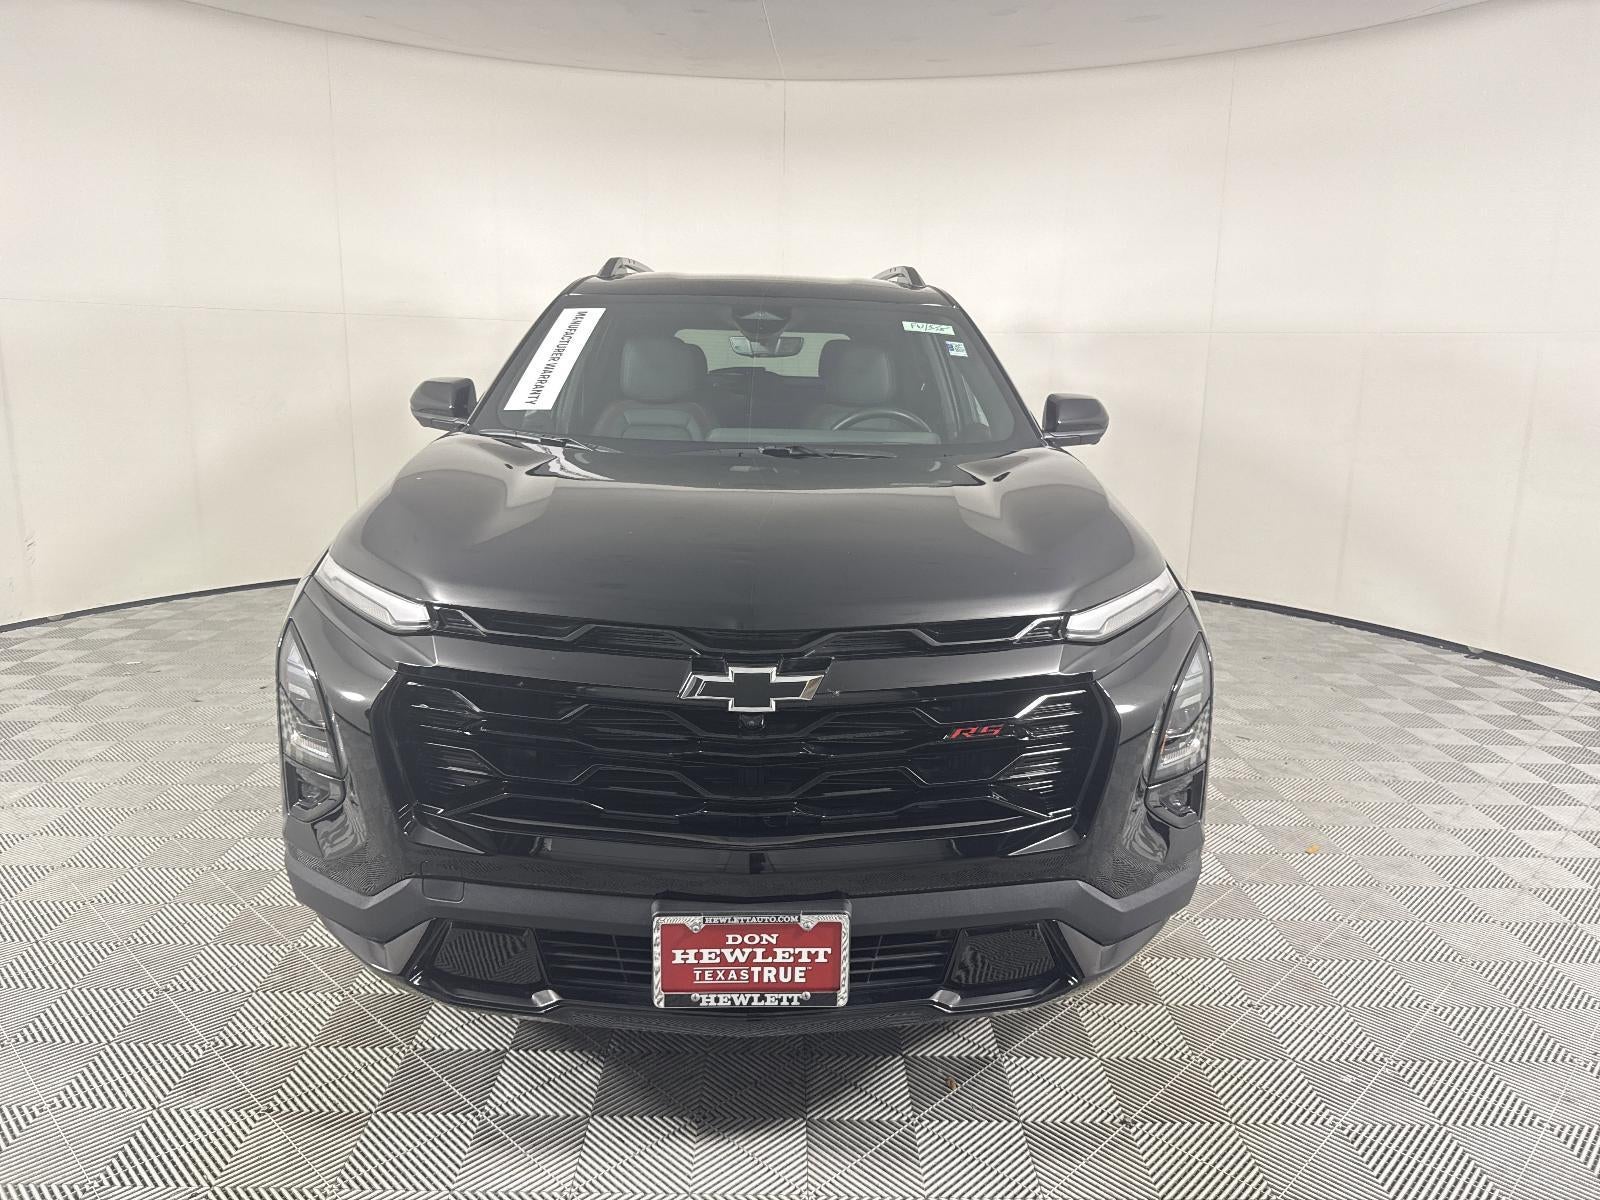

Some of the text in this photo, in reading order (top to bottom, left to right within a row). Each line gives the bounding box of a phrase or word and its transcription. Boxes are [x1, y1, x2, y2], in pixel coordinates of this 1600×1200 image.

[524, 311, 588, 405] MANUFACTURER WARRANTY
[950, 723, 1004, 739] RS
[704, 916, 800, 924] HEWLETTAUTO.COM
[725, 933, 779, 945] DON
[671, 947, 832, 964] HEWLETT
[693, 969, 749, 981] TEXAS
[699, 993, 800, 1006] HEWLETT
